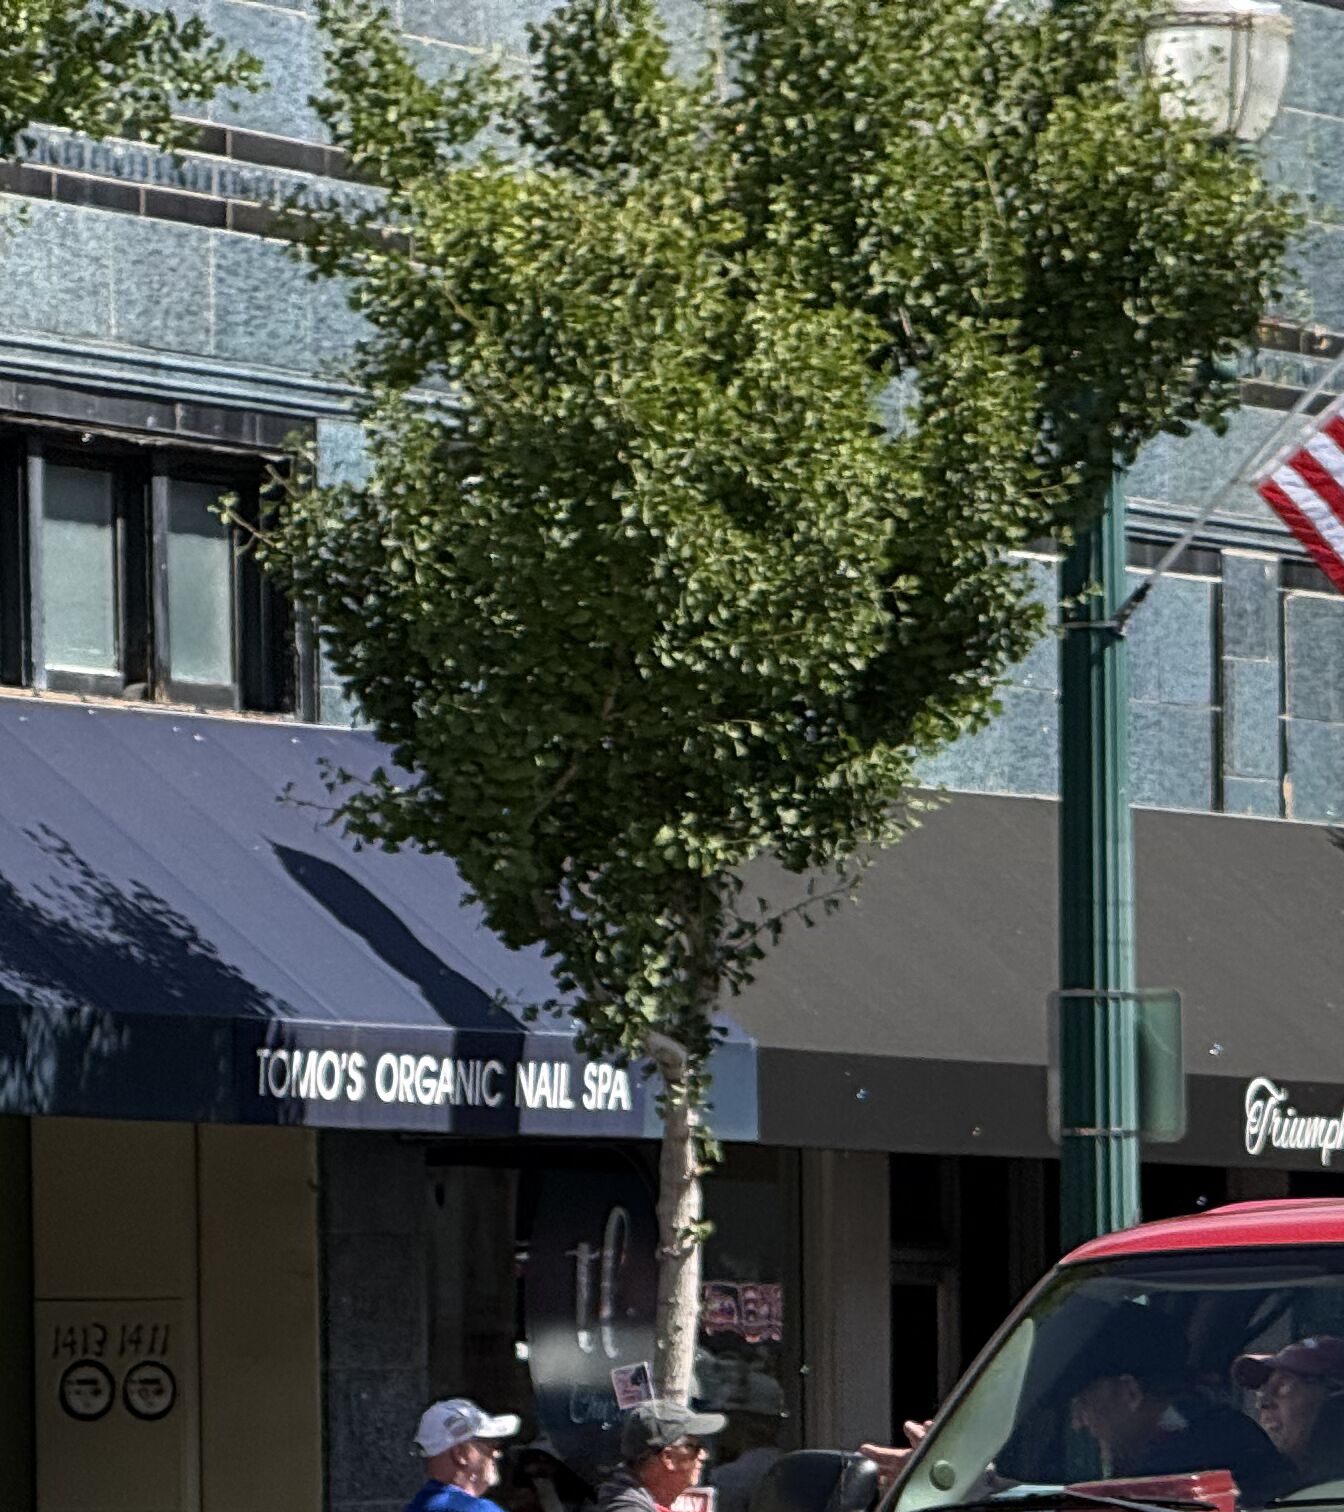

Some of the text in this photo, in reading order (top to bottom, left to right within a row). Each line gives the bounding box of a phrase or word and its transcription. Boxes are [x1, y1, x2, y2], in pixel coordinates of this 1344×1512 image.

[256, 1047, 633, 1111] TOMO'S ORGANIC NAIL SPA
[52, 1322, 170, 1358] 1413 1411
